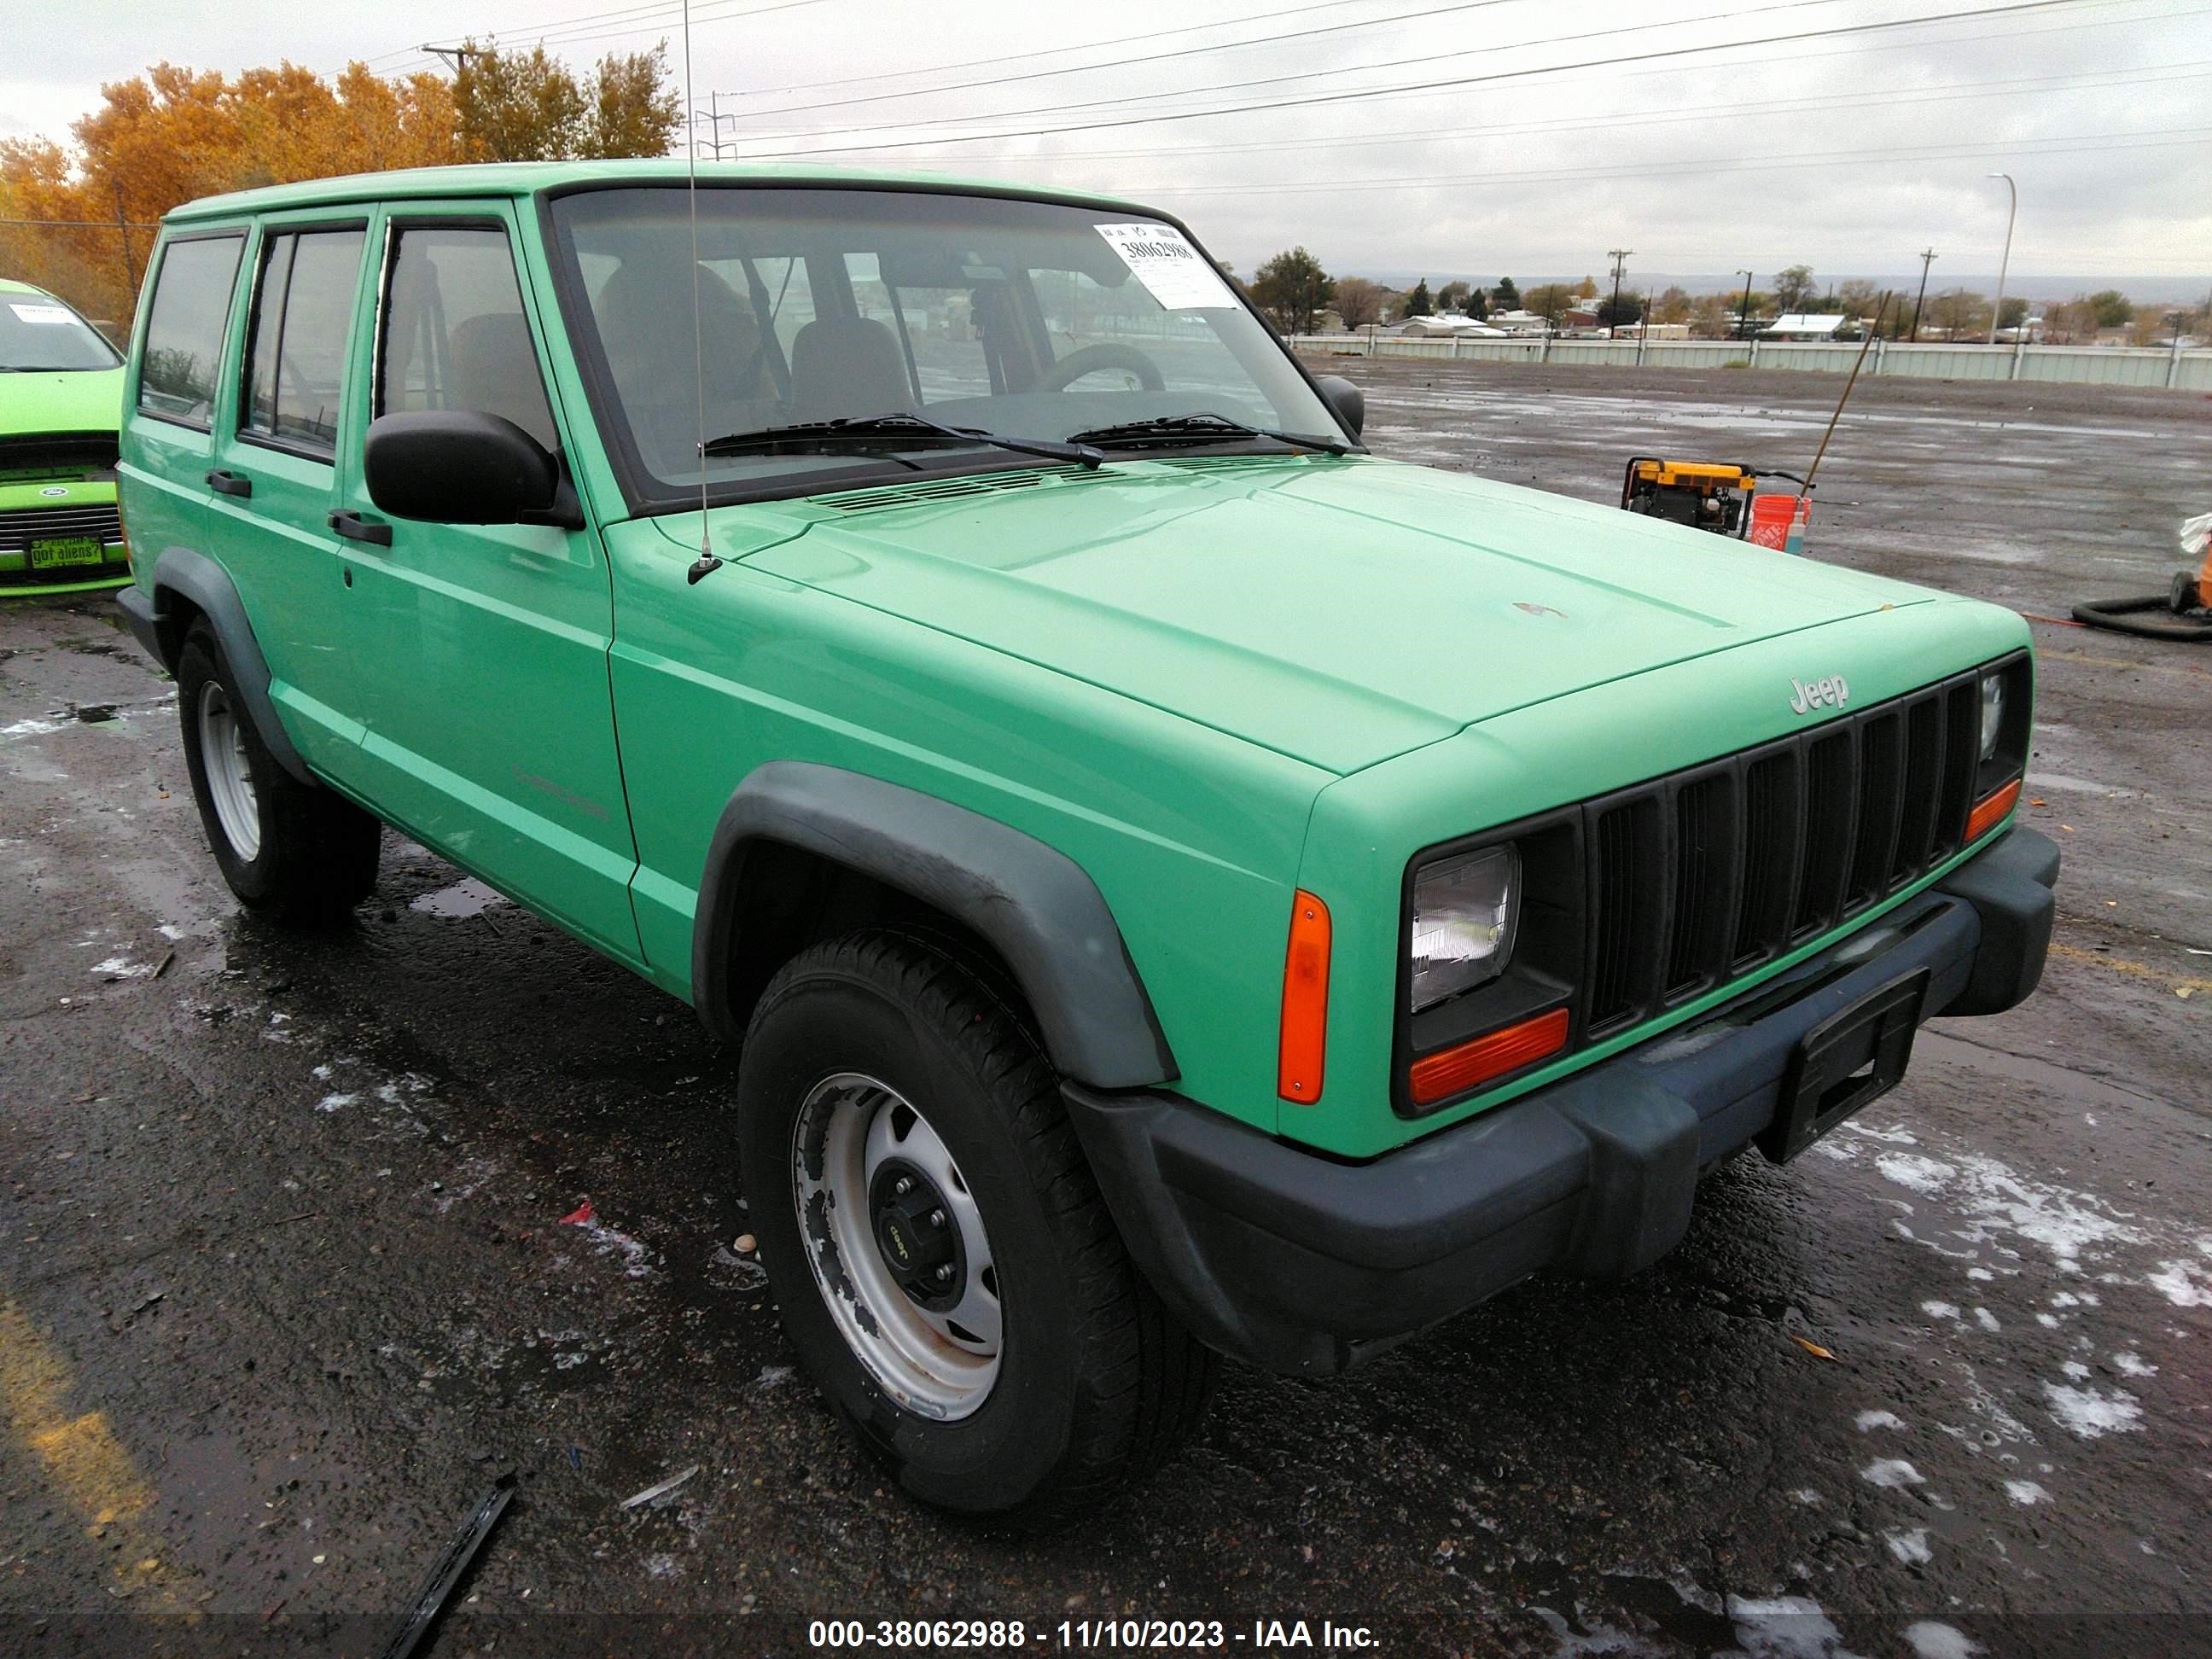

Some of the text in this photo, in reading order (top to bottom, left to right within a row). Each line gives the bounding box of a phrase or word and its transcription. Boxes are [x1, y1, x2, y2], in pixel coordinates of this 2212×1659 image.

[1121, 242, 1193, 259] 38062988
[33, 544, 99, 564] got aliens?
[1790, 676, 1848, 714] Jeep
[890, 1226, 908, 1259] Jeep
